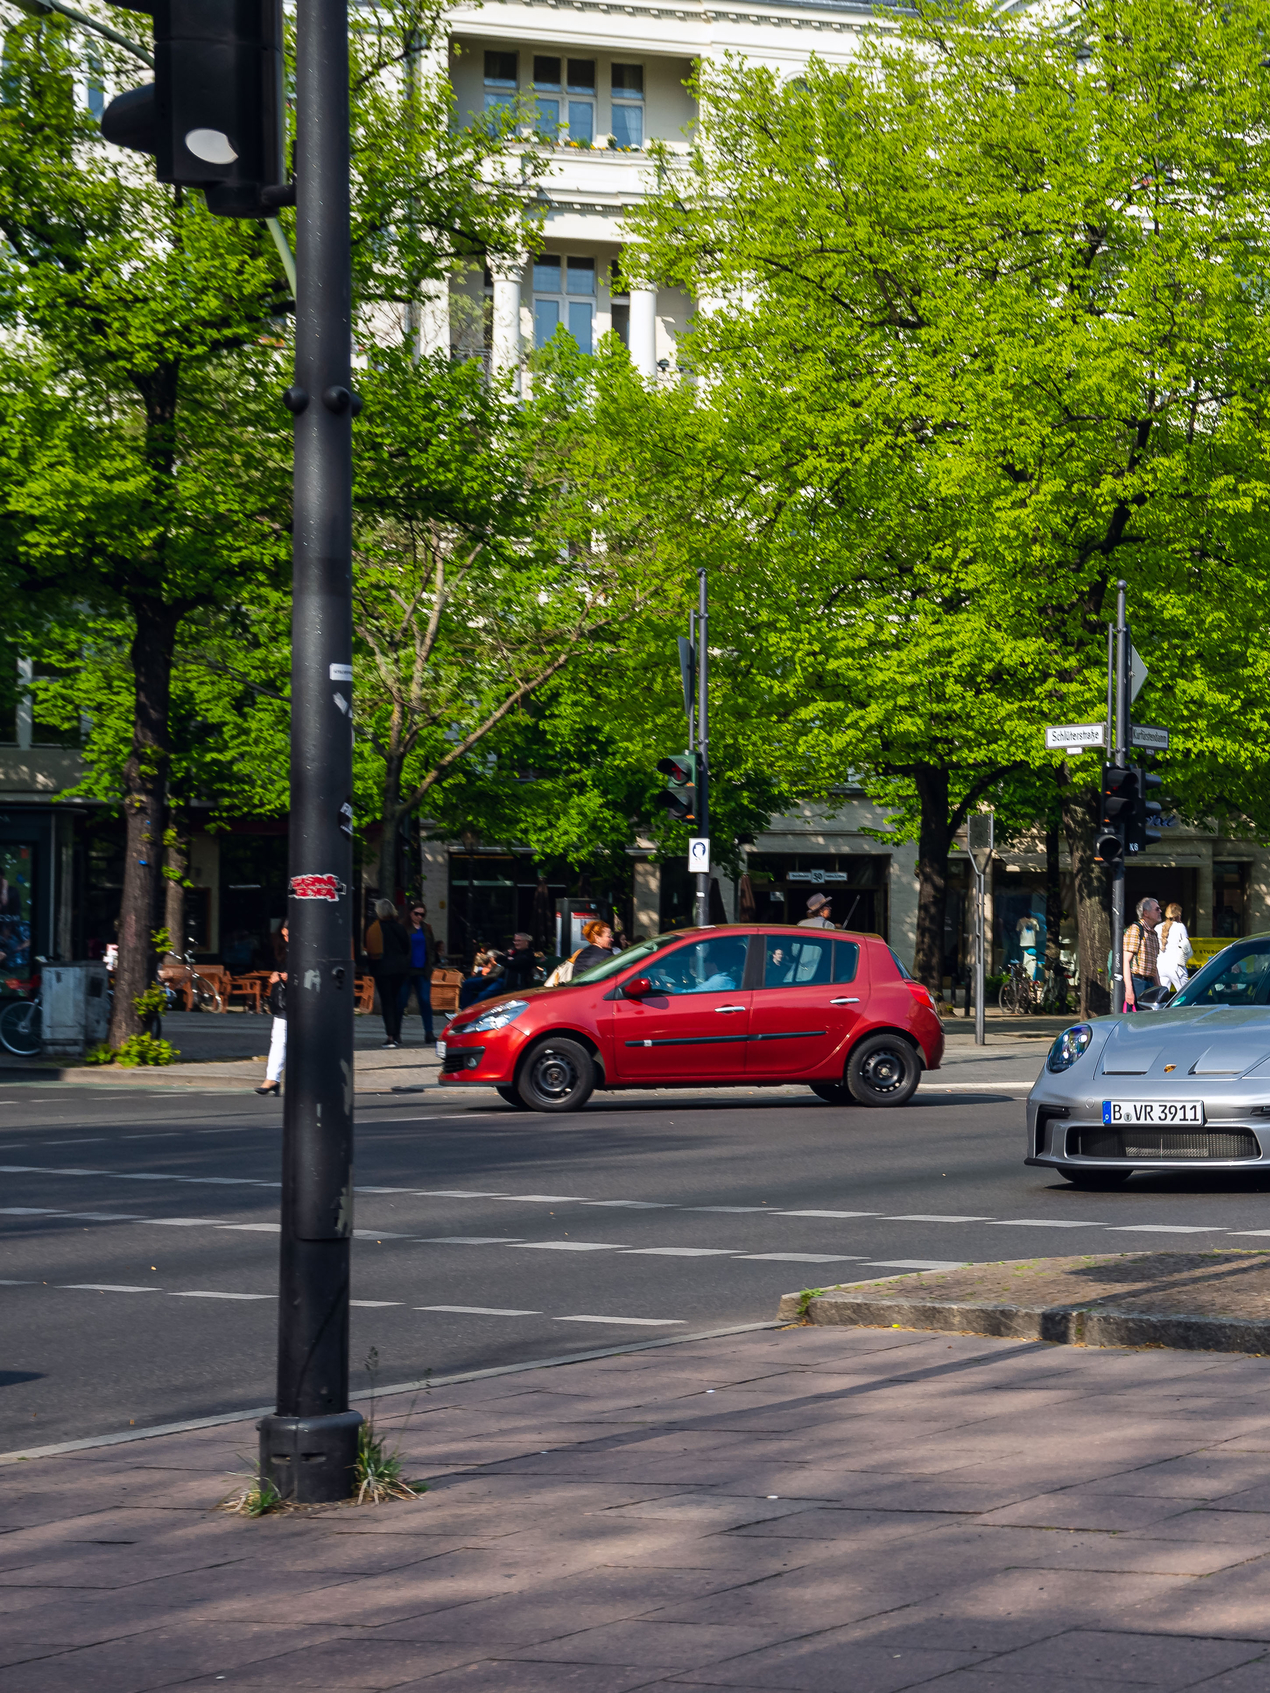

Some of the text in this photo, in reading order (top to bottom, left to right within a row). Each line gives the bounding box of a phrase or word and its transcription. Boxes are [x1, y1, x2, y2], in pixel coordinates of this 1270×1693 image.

[1051, 729, 1100, 742] Schlüterstraße
[1112, 1104, 1200, 1122] B VR 3911
